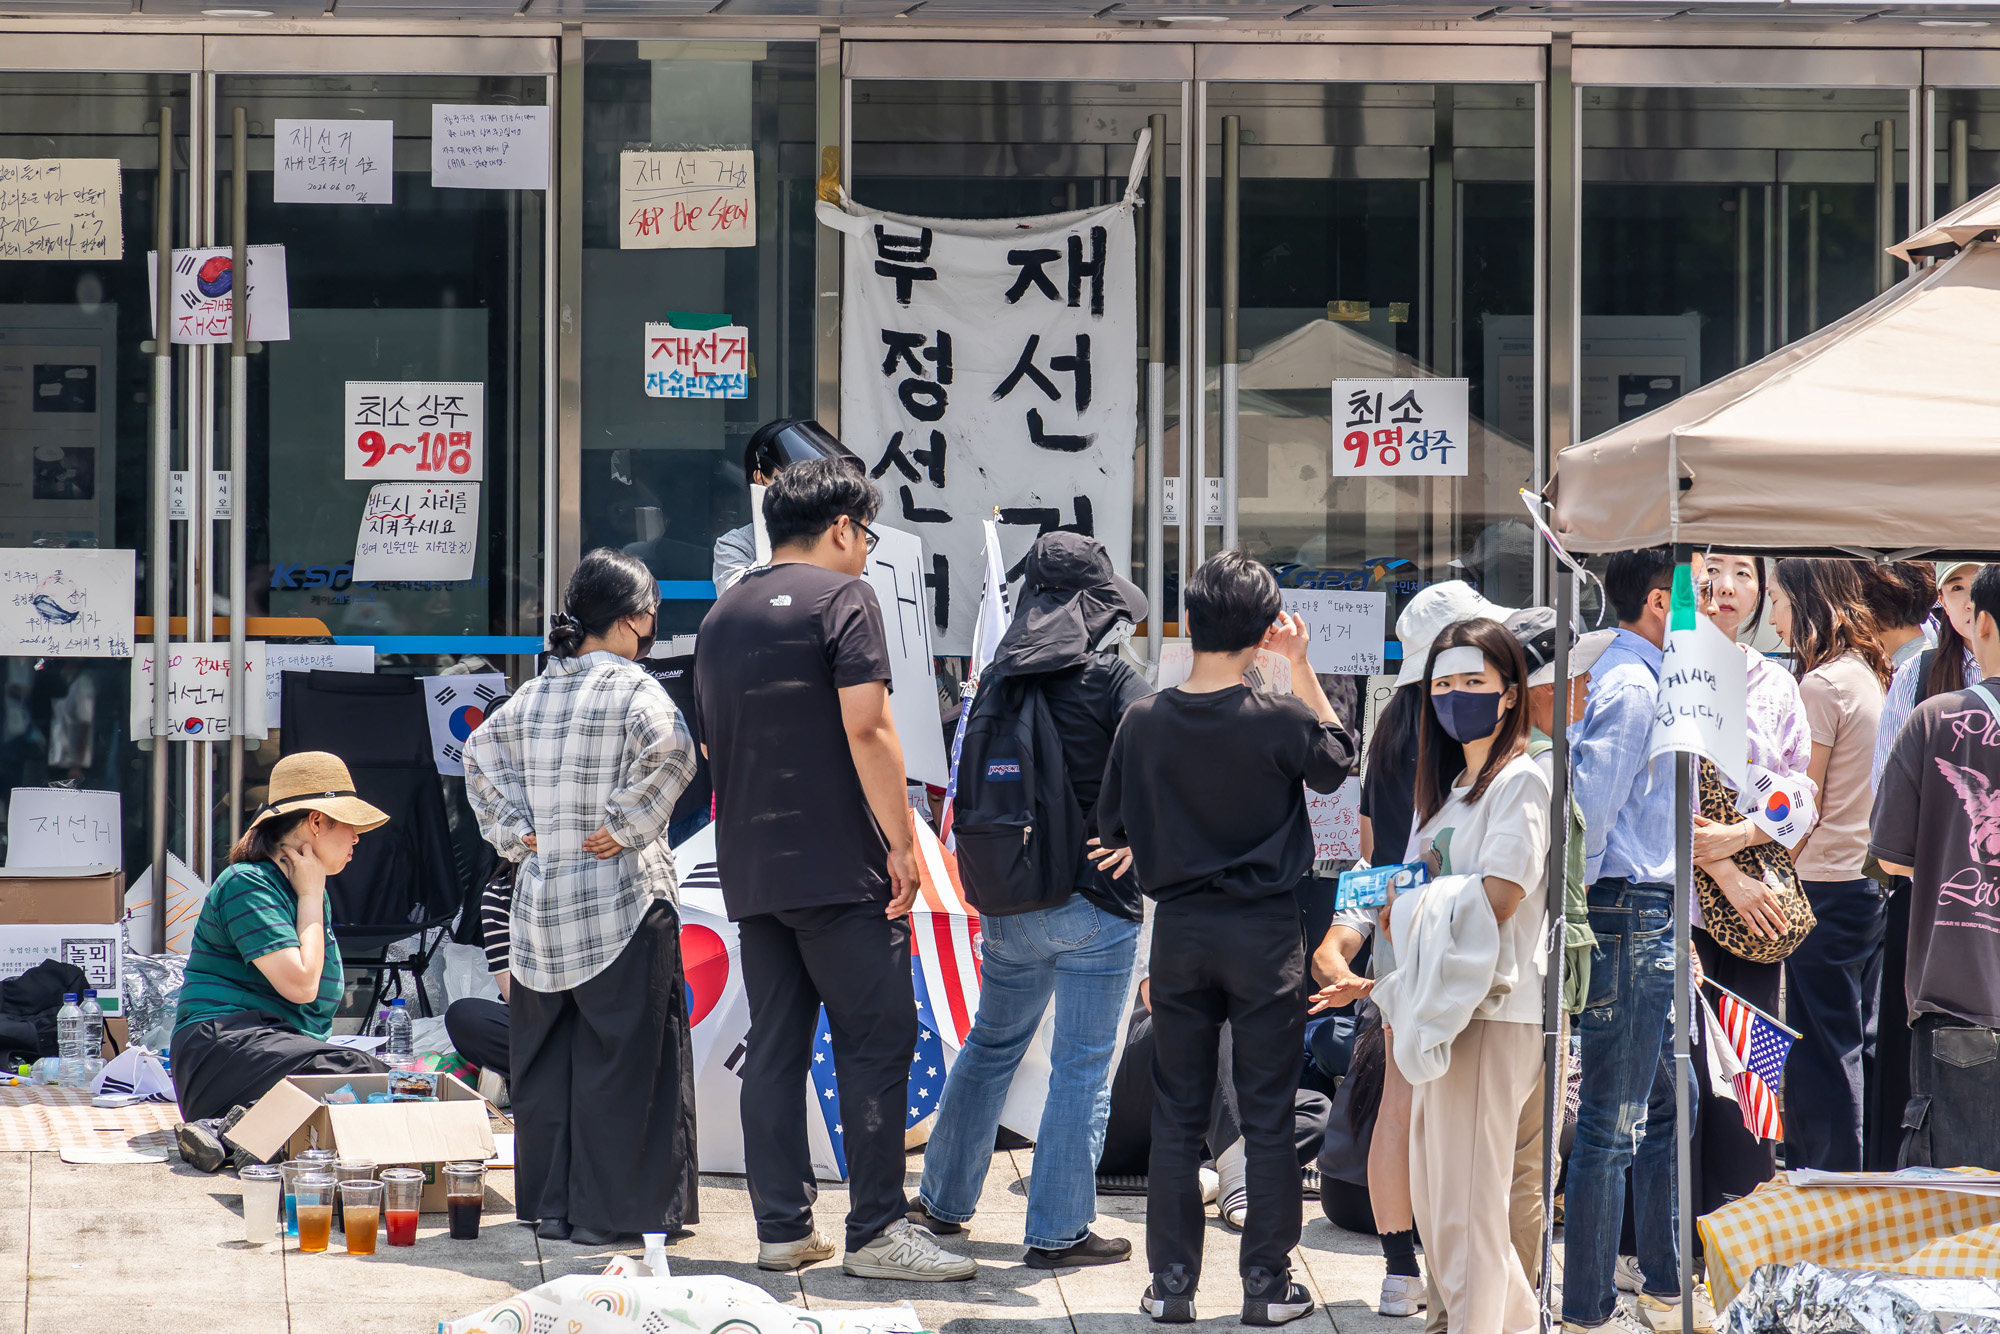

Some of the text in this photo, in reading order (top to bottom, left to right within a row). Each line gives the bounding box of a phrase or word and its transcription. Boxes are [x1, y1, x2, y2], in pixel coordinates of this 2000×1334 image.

[633, 157, 733, 185] 재선거
[670, 202, 703, 232] the
[651, 332, 747, 378] 재선거
[354, 395, 468, 428] 최소 상주
[1346, 389, 1423, 428] 최소
[358, 430, 472, 474] 9~10명
[368, 490, 467, 515] 반드시 자리를
[266, 654, 334, 667] 자유 대한민국을
[29, 814, 110, 844] 재선거
[70, 945, 106, 963] 놀뫼
